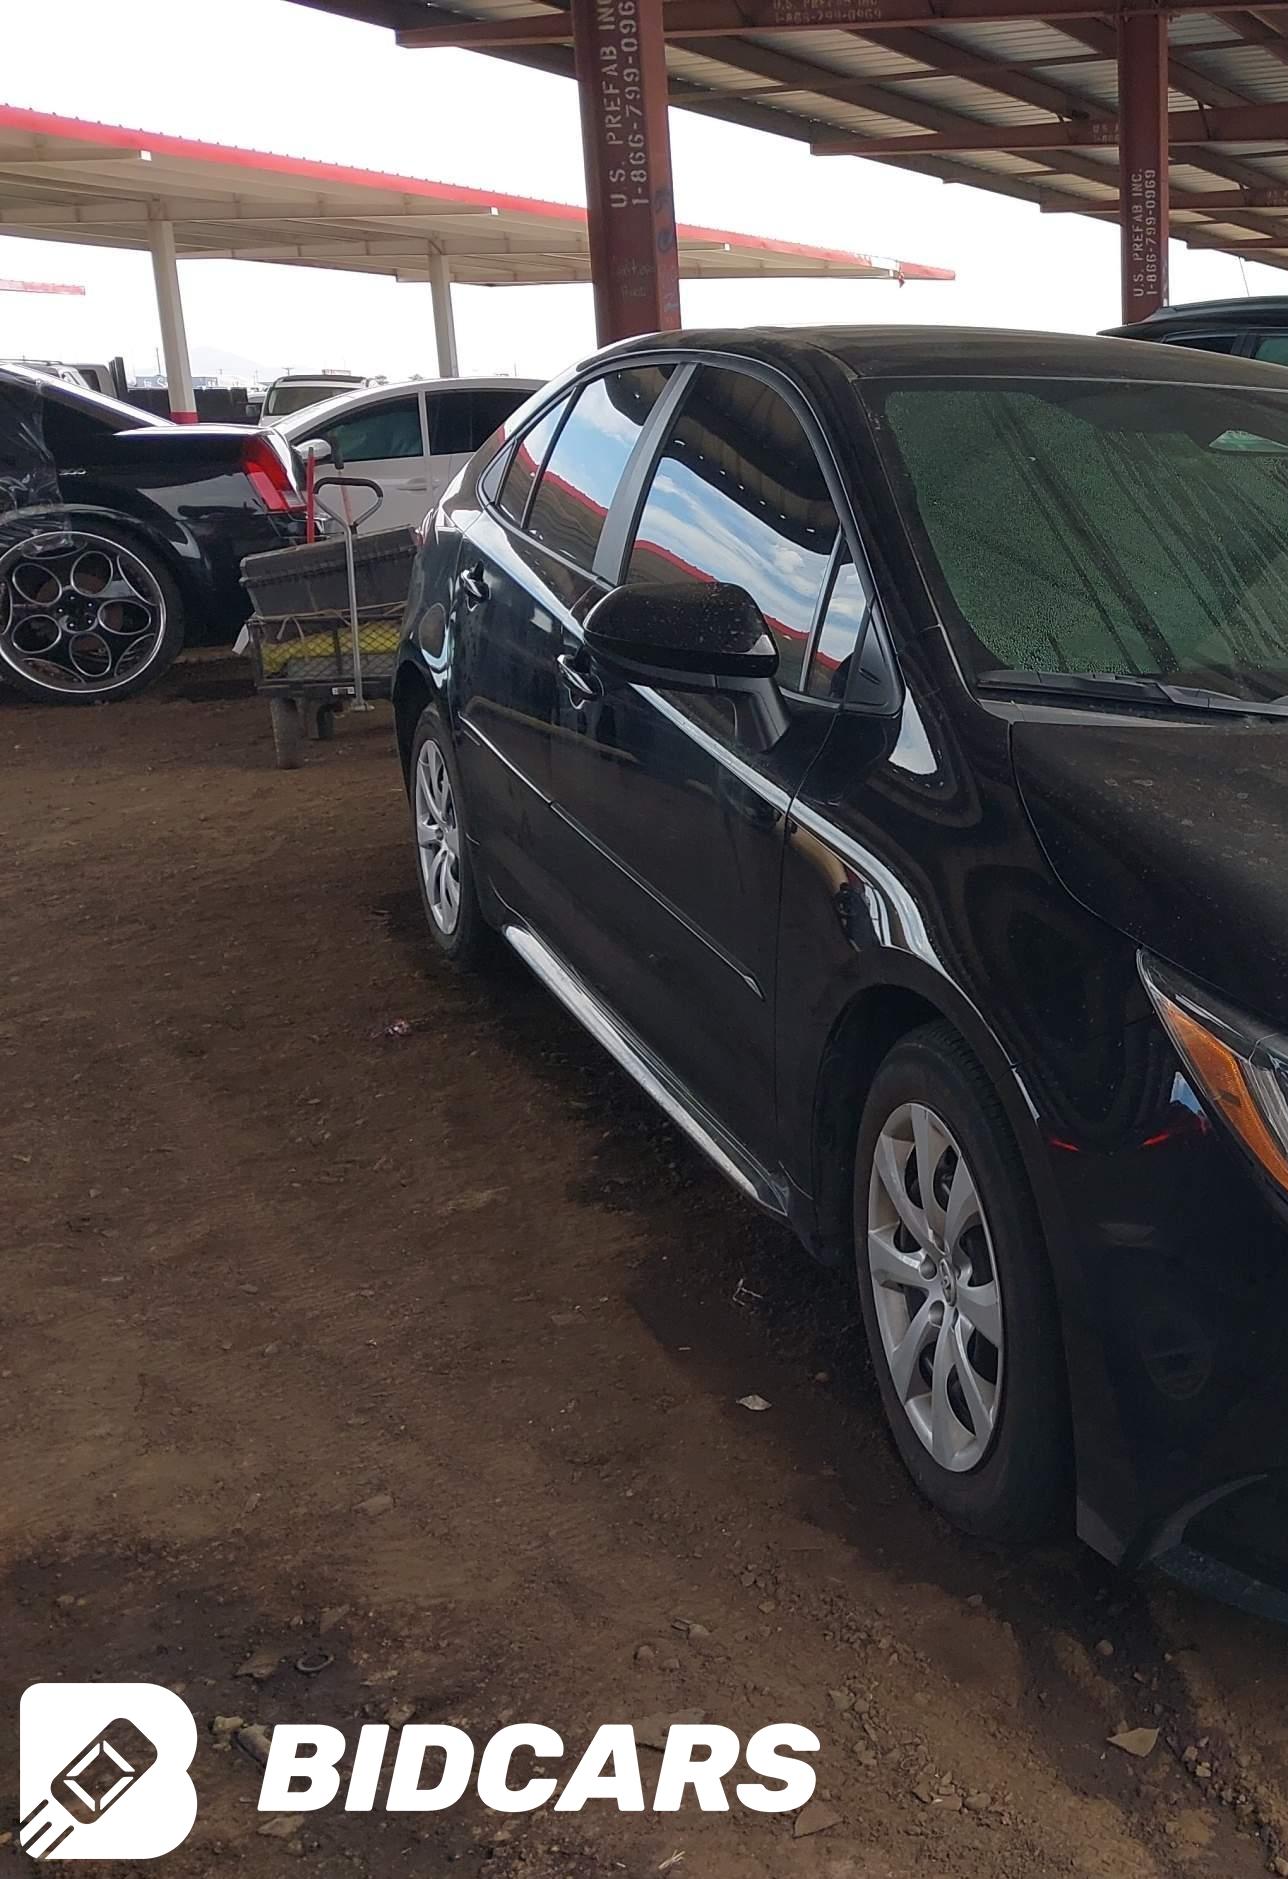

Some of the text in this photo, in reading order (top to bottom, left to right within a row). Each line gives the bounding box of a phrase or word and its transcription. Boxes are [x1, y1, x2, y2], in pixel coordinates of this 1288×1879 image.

[597, 0, 628, 208] U.S. PREFAB IN
[1131, 168, 1145, 297] U.S. PREFAB INC.
[1144, 169, 1158, 295] 1-866-799-0969
